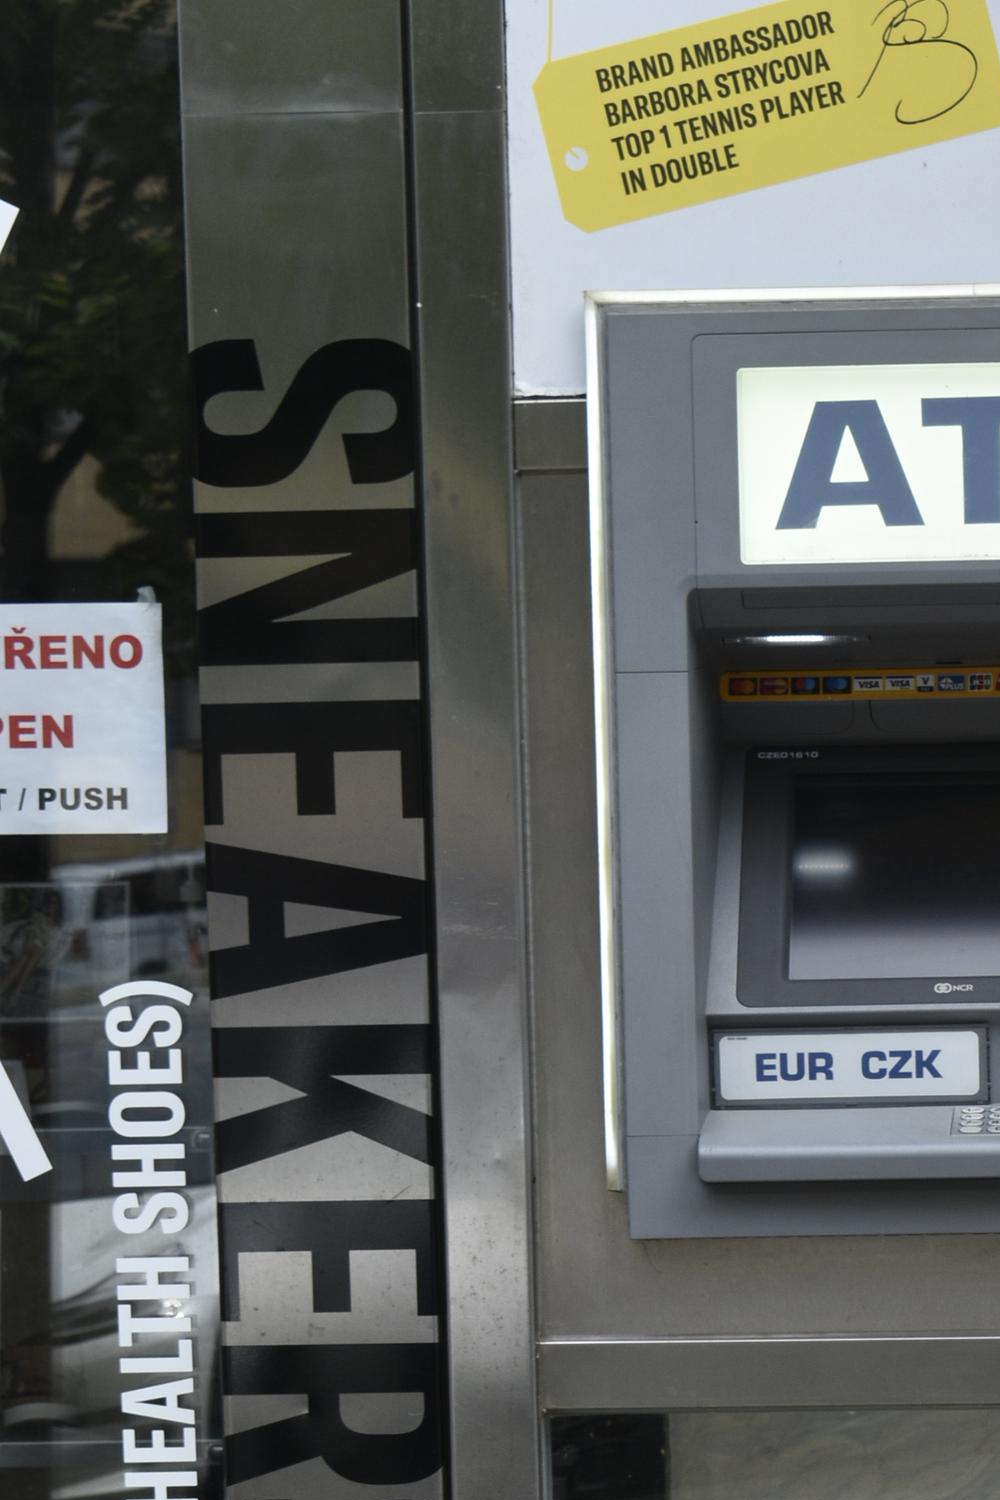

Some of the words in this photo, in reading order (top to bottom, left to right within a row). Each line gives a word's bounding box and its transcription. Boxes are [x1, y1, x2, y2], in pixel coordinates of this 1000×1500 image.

[596, 52, 674, 93] BRAND
[680, 11, 835, 72] AMBASSADOR
[603, 80, 713, 128] BARBORA
[714, 48, 831, 99] STRYCOVA
[610, 129, 655, 161] TOP
[659, 124, 672, 149] 1
[673, 102, 758, 145] TENNIS
[759, 81, 846, 124] PLAYER
[620, 167, 647, 196] IN
[649, 143, 740, 188] DOUBLE
[0, 626, 143, 670] ŘENO
[0, 714, 74, 749] EN
[38, 787, 129, 811] PUSH
[953, 984, 973, 992] NCR
[755, 1052, 834, 1082] EUR
[861, 1050, 943, 1080] CZK
[99, 980, 193, 1235] SHOES)
